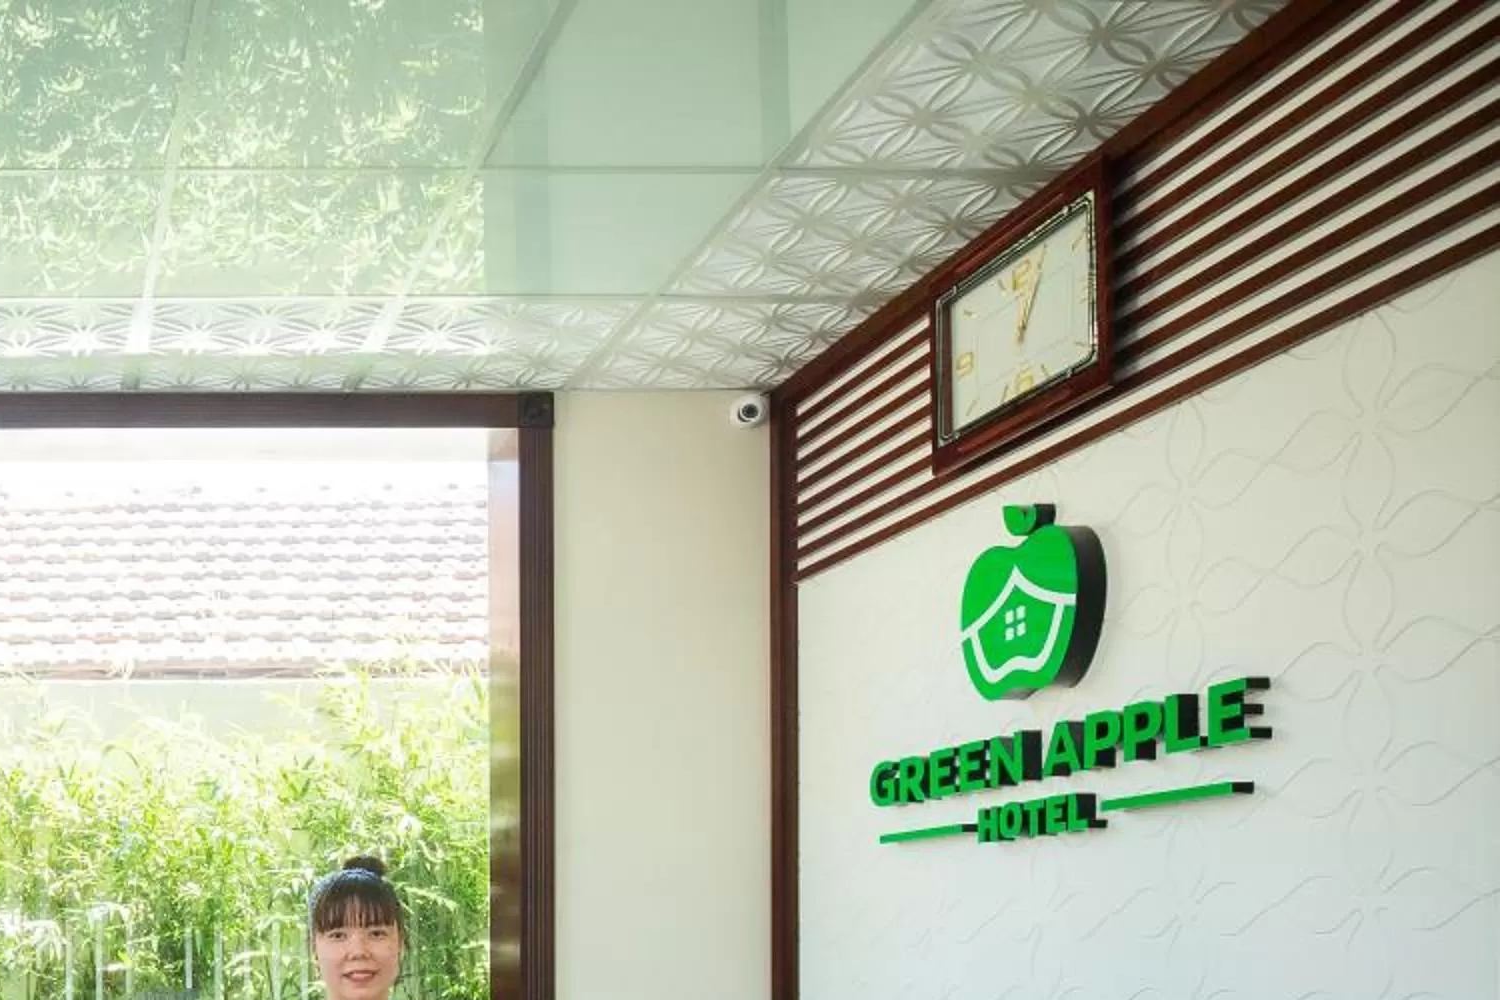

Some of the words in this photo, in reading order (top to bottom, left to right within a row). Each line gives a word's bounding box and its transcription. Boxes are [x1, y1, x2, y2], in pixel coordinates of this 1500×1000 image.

[870, 731, 1036, 806] GREEN
[1043, 678, 1264, 778] APPLE
[978, 794, 1097, 842] HOTEL
